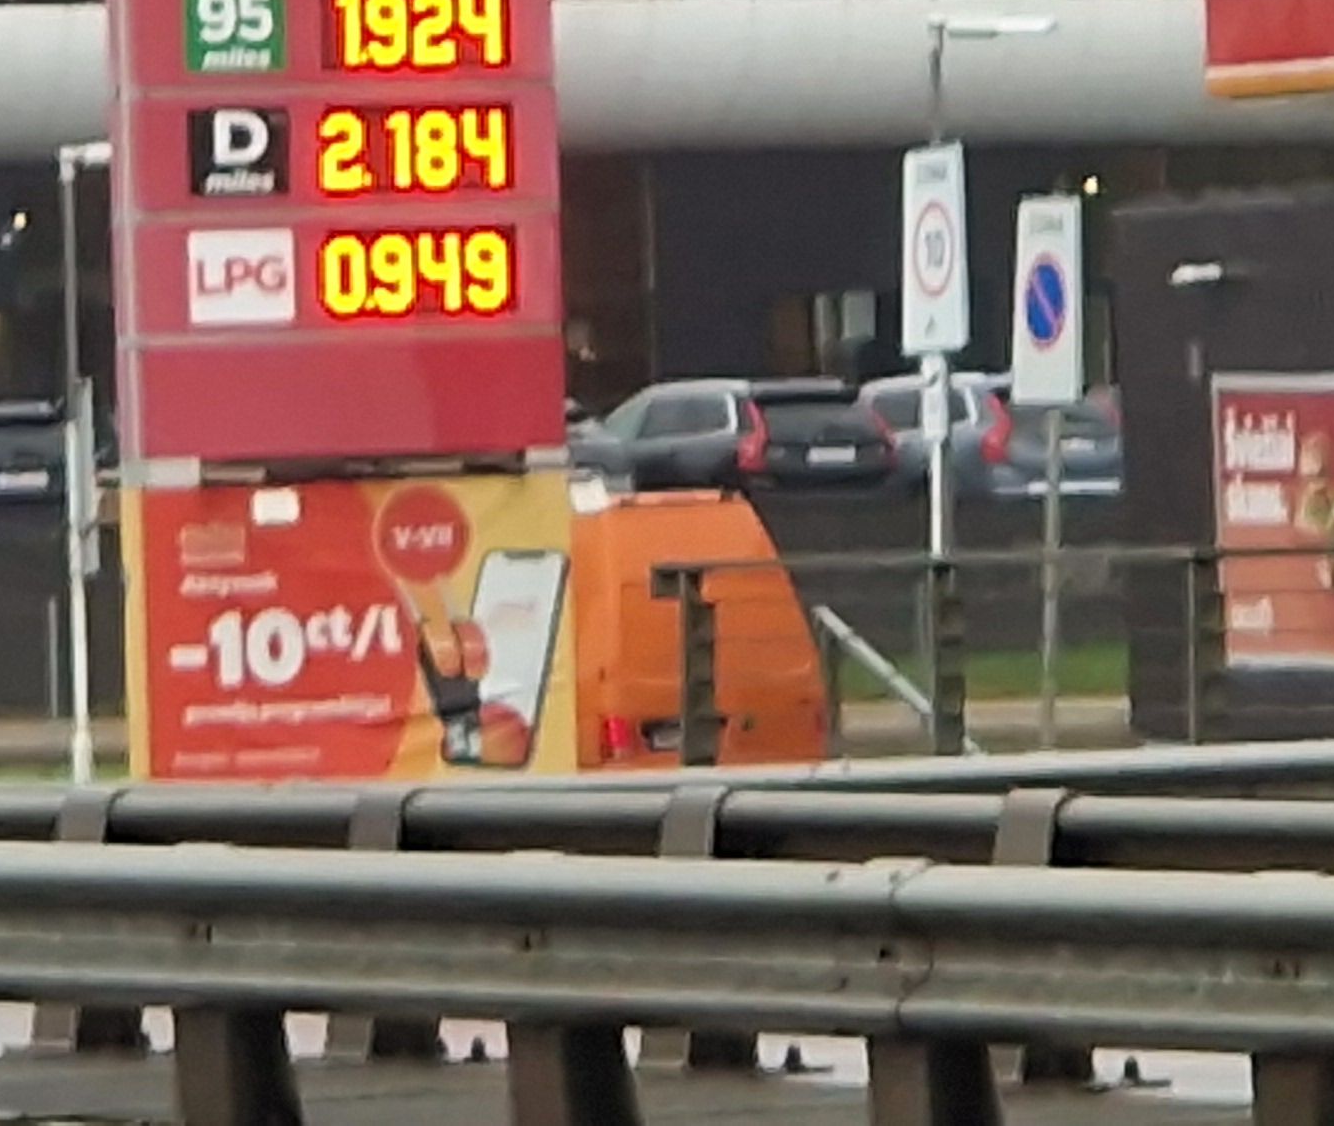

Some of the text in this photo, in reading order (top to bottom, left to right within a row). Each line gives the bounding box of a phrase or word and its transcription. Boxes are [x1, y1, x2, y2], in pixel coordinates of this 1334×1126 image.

[213, 109, 269, 166] D
[319, 107, 507, 192] 2.184
[197, 255, 287, 297] LPG
[322, 230, 508, 314] 0.949
